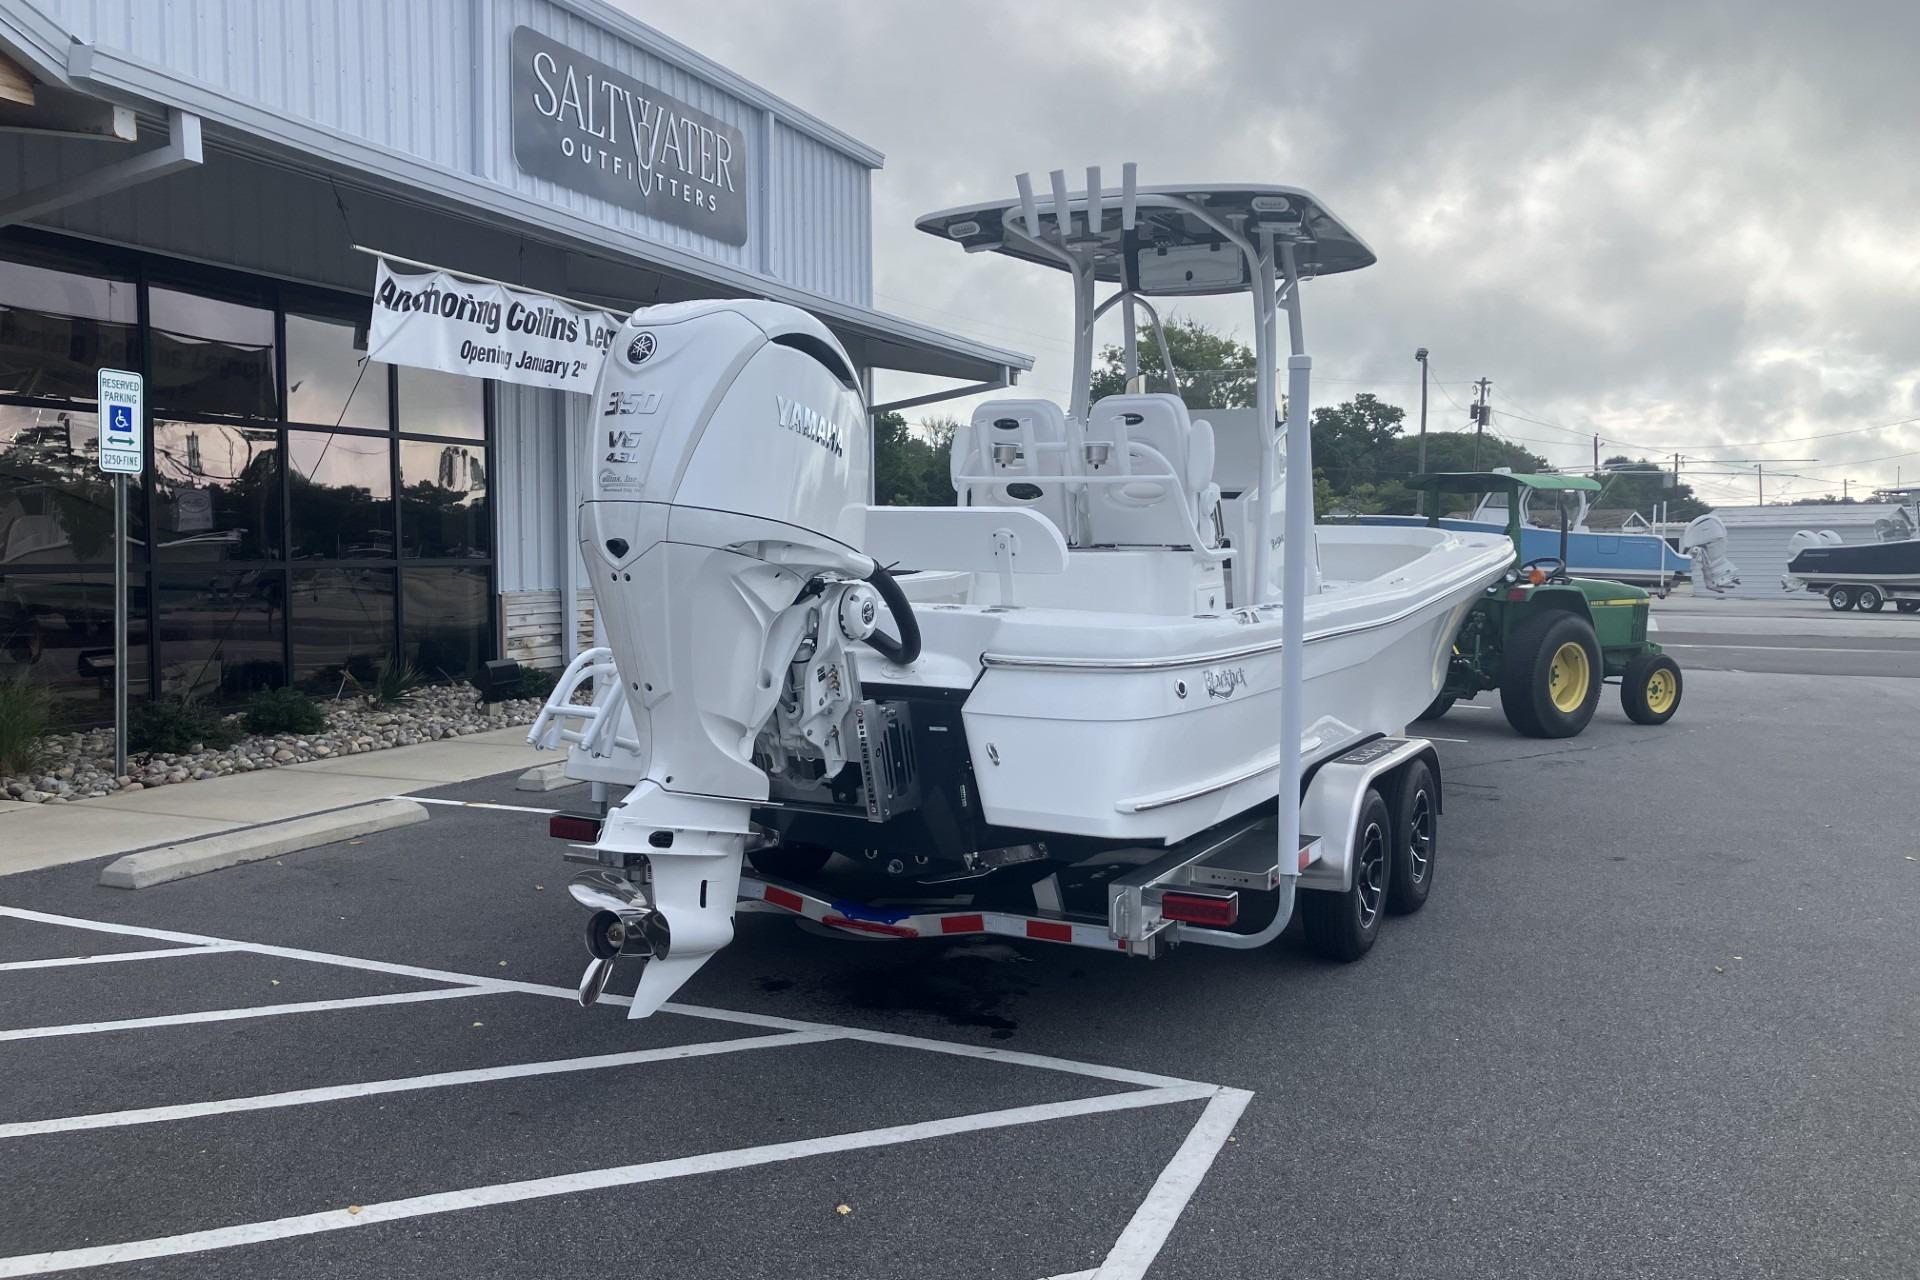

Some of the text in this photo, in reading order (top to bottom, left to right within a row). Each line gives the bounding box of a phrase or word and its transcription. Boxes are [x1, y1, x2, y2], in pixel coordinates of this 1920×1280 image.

[532, 51, 735, 196] SALTWATER
[561, 137, 717, 212] OUTFITTERS
[375, 276, 500, 334] Anchoring
[102, 377, 140, 392] RESERVED
[460, 339, 512, 370] Opening
[515, 350, 569, 379] January
[104, 391, 137, 404] PARKING
[776, 394, 843, 458] YAMAHA
